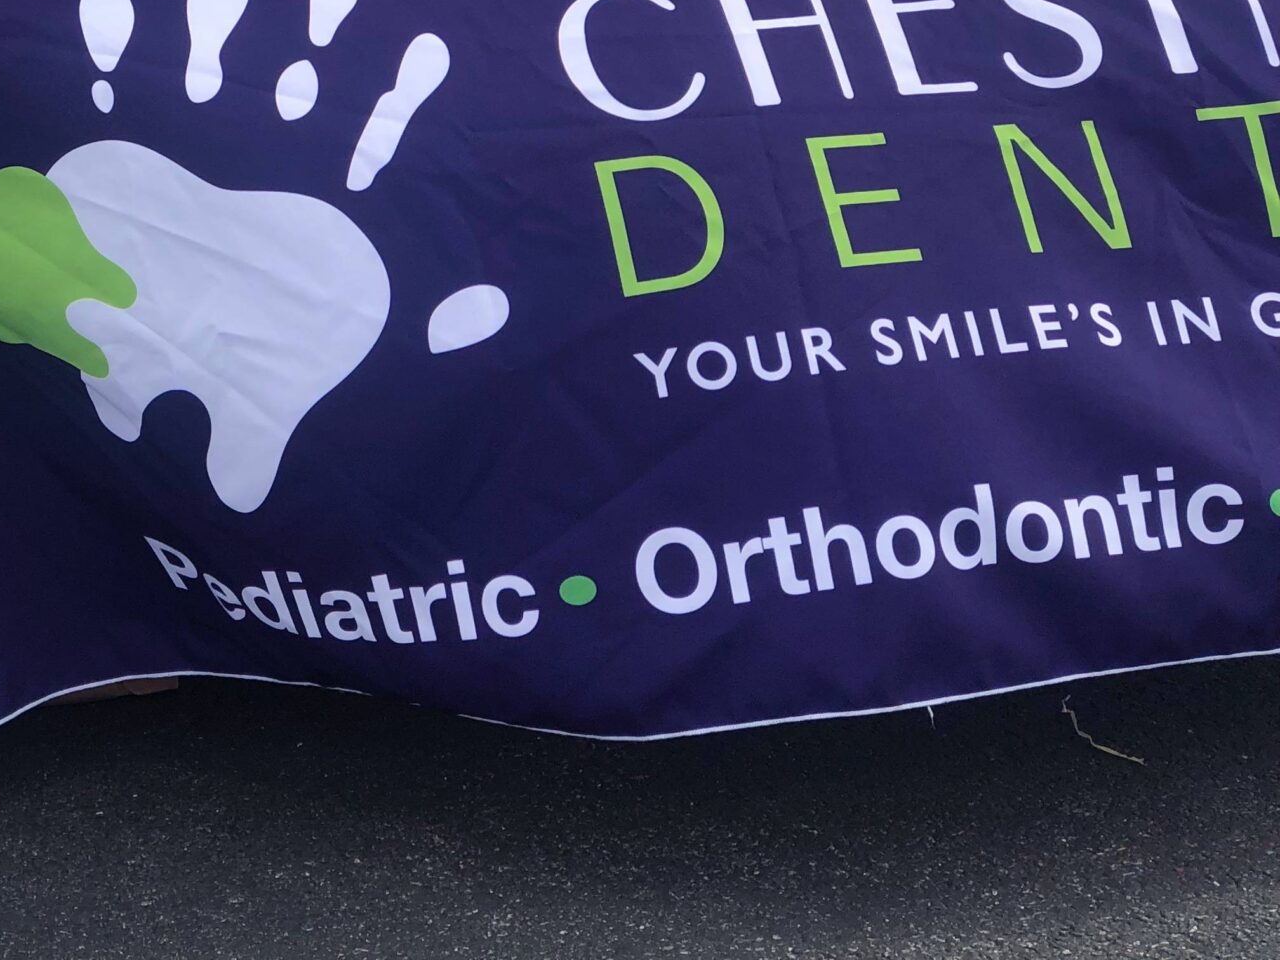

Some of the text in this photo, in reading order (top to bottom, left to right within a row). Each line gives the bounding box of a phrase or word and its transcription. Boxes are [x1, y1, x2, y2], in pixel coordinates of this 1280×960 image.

[594, 100, 1280, 297] DENT
[633, 327, 847, 399] YOUR
[869, 302, 1123, 366] SMILE'S
[1146, 296, 1222, 346] IN
[144, 466, 1245, 644] Pediatric Orthodontic
